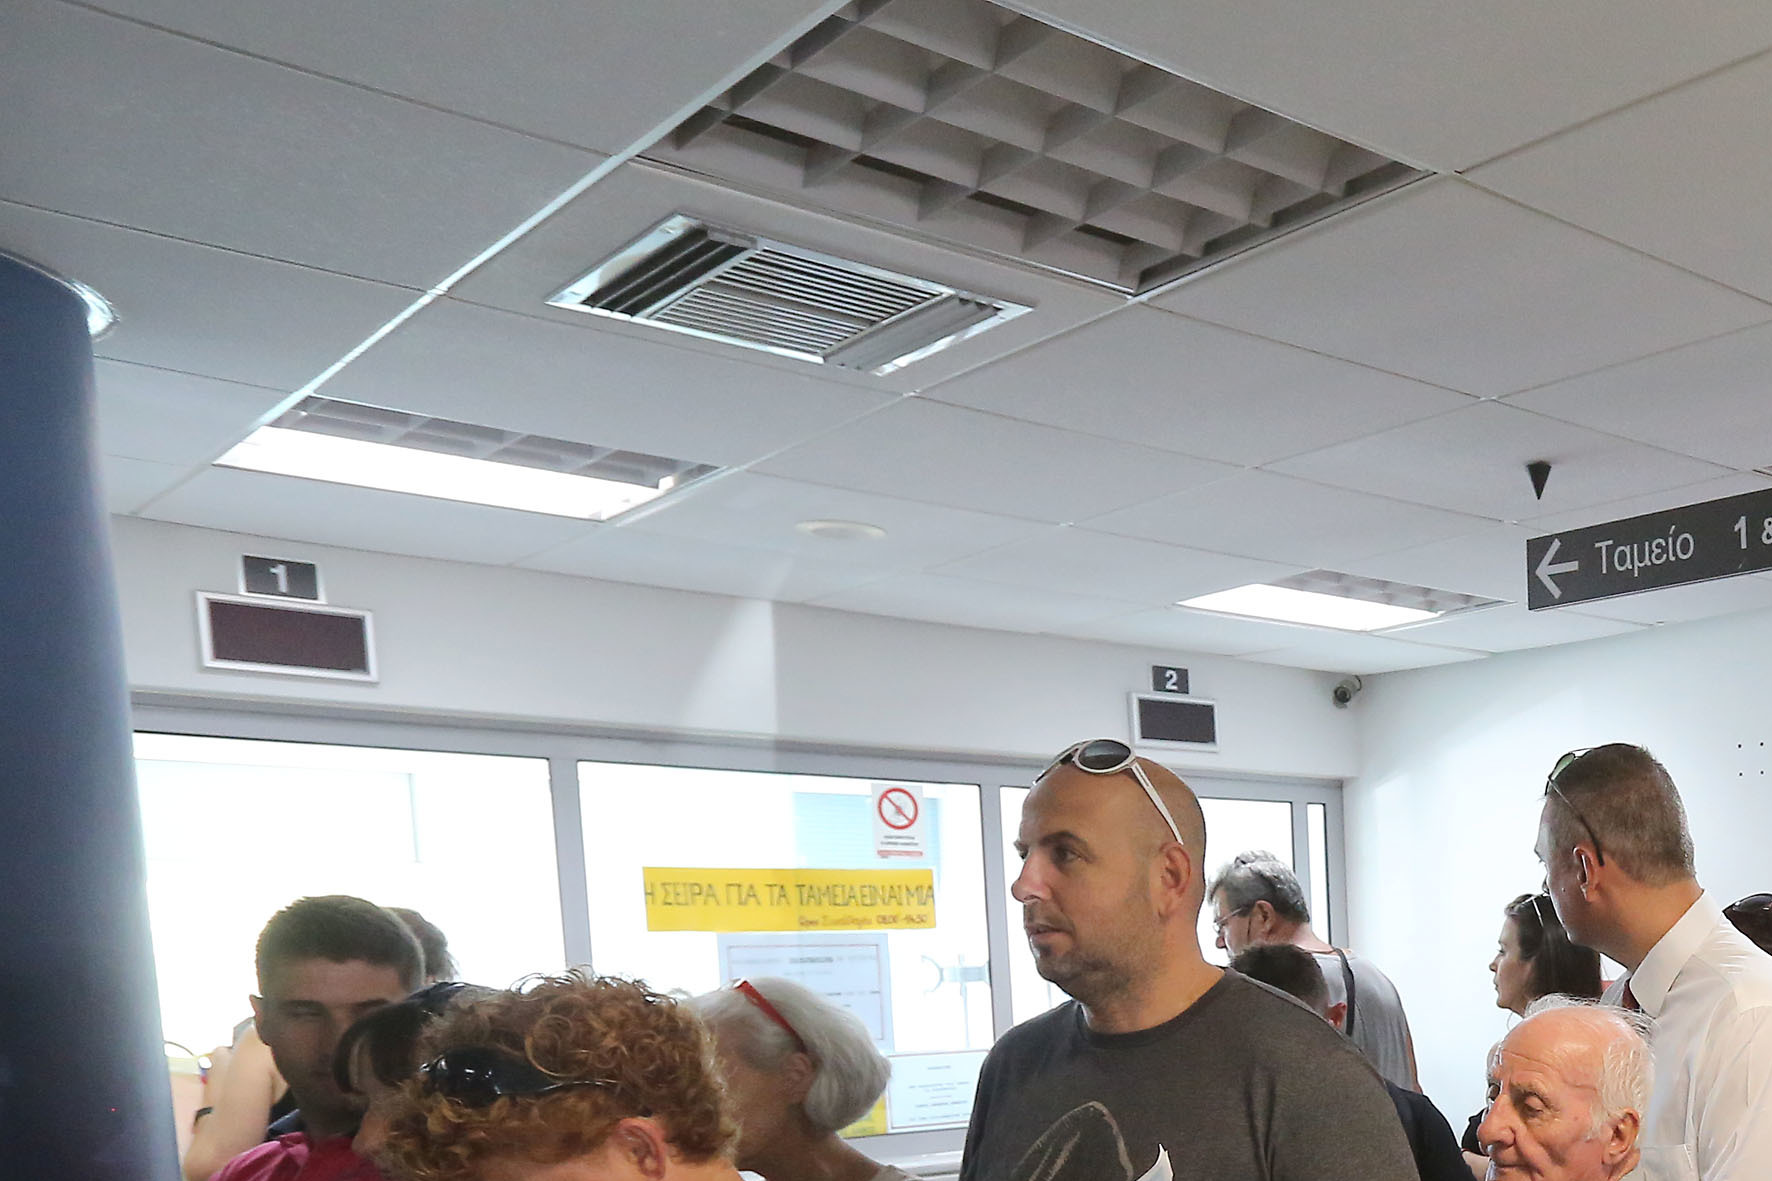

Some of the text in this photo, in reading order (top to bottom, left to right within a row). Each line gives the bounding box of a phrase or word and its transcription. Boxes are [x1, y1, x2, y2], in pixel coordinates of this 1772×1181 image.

[1595, 524, 1695, 578] Ταμείο
[1734, 515, 1748, 550] 1
[269, 563, 289, 593] 1
[1165, 669, 1179, 691] 2
[661, 882, 721, 906] ΣΕΙΡΑ
[725, 882, 762, 906] ΓΙΑ
[764, 883, 791, 906] ΤΑ
[795, 883, 859, 906] ΤΑΜΕΙΑ
[860, 884, 904, 907] ΕΙΝΑΙ
[905, 884, 935, 906] ΜΙΑ
